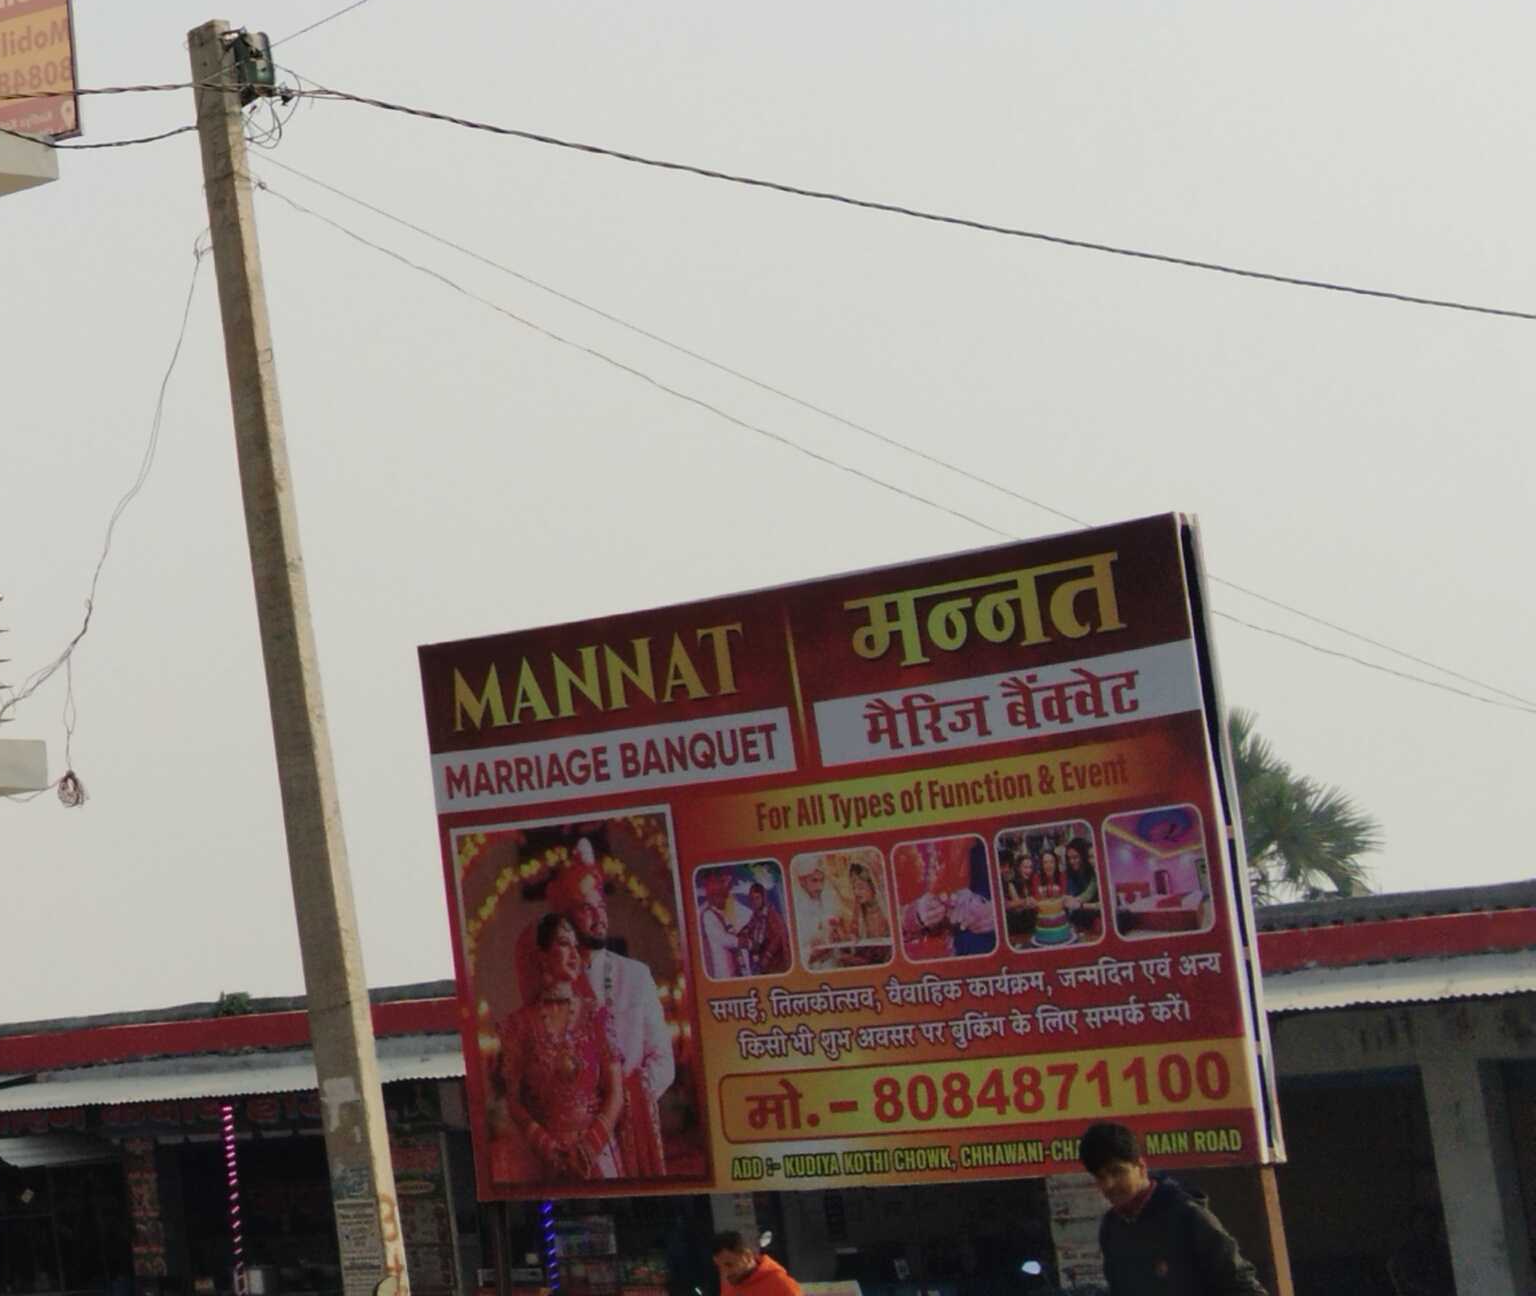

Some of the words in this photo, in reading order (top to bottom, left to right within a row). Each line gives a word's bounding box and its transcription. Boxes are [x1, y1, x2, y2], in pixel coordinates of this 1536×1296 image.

[844, 551, 1126, 667] मन्नत
[452, 622, 743, 732] MANNAT
[863, 693, 992, 750] मैरिज
[1000, 666, 1139, 728] बैंक्वेट
[445, 745, 610, 802] MARRIAGE
[620, 722, 777, 779] BANQUET
[757, 802, 790, 832] For
[796, 797, 826, 827] All
[830, 789, 895, 828] Types
[900, 783, 925, 816] of
[929, 772, 1030, 812] Function
[1040, 768, 1054, 794] &
[1062, 756, 1129, 791] Event
[711, 990, 767, 1022] सगाई,
[887, 975, 962, 1005] वैवाहिक
[967, 966, 1053, 997] कार्यक्रम,
[1057, 956, 1136, 988] जन्मदिन
[1140, 952, 1171, 983] एवं
[1179, 953, 1221, 976] अन्य
[739, 1027, 788, 1059] किसी
[791, 1024, 814, 1056] भी
[820, 1029, 851, 1061] शुभ
[857, 1023, 917, 1049] अवसर
[920, 1021, 946, 1044] पर
[949, 1011, 1006, 1048] बुकिंग
[1009, 1010, 1031, 1034] के
[1036, 1004, 1078, 1034] लिए
[1084, 996, 1144, 1028] सम्पर्क
[874, 1050, 1230, 1122] 8084871100
[732, 1157, 764, 1181] ADD
[784, 1153, 841, 1178] KUDIYA
[843, 1150, 890, 1176] KOTHI
[894, 1145, 956, 1173] CHOWK,
[960, 1136, 1082, 1167] CHHAWANI-CHA
[1146, 1131, 1188, 1155] MAIN
[1194, 1129, 1243, 1152] ROAD
